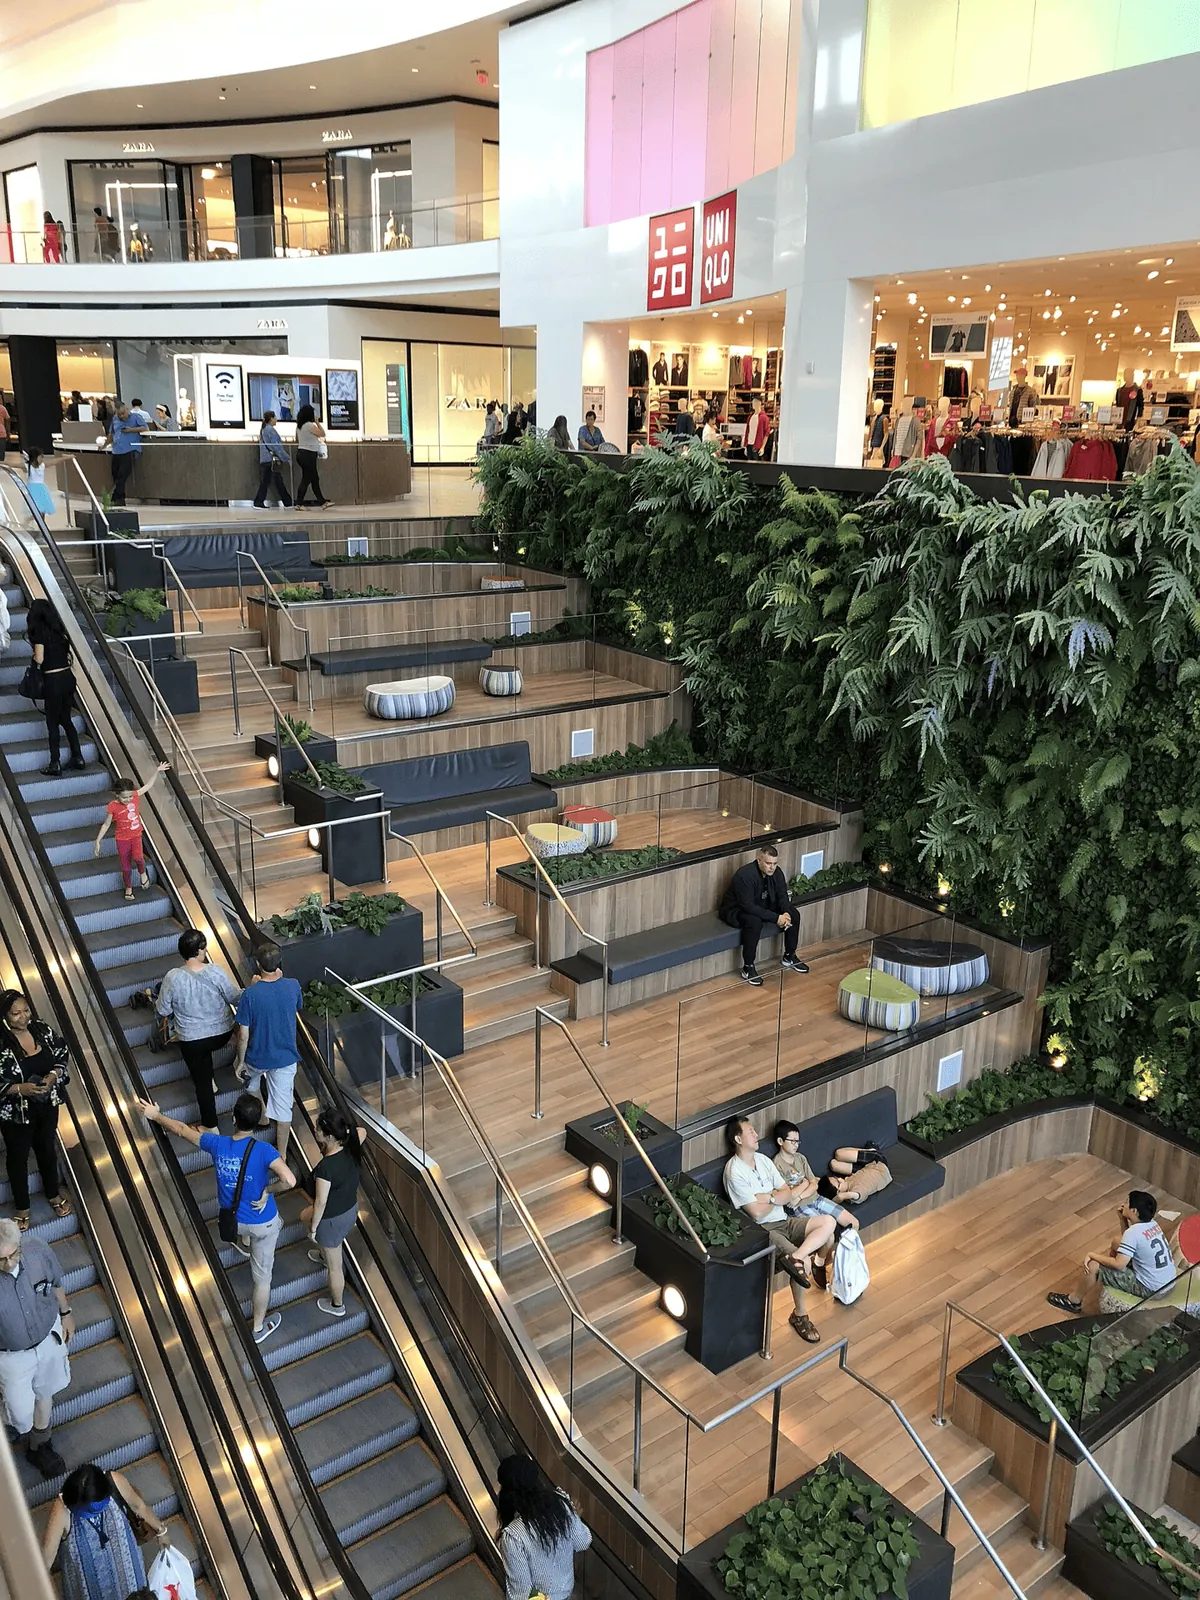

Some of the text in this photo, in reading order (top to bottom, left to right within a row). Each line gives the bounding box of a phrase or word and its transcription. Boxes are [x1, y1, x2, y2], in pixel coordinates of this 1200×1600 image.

[322, 130, 353, 142] ZARA
[122, 142, 155, 153] ZARA
[705, 207, 730, 249] UNI
[704, 249, 731, 295] QLO
[256, 319, 289, 329] ZARA
